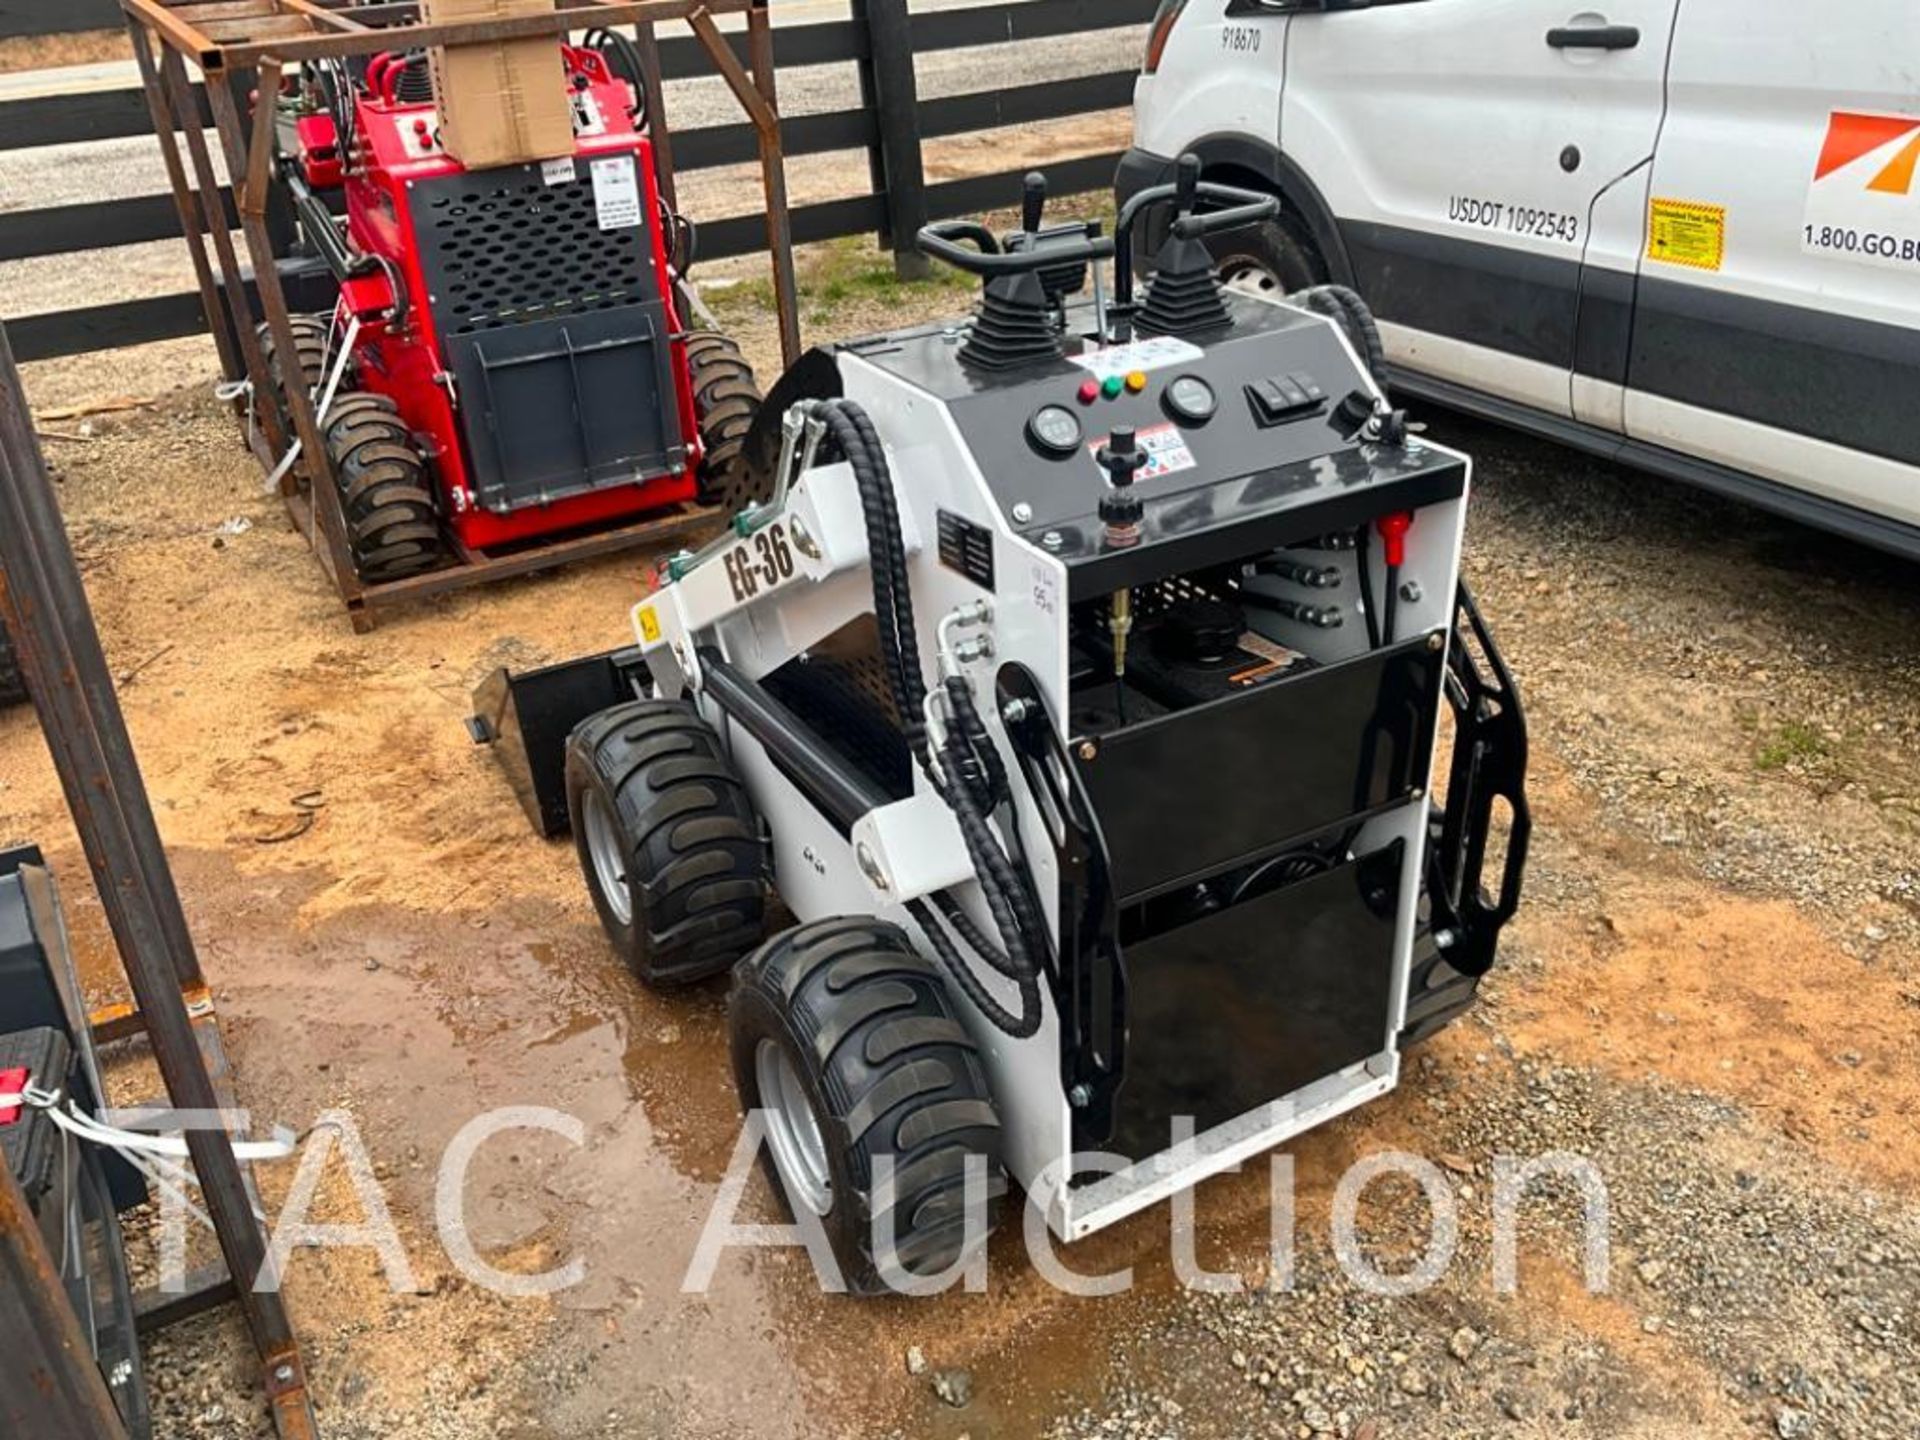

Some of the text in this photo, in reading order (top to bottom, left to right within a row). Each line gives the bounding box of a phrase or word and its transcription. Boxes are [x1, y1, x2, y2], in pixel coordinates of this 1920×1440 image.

[1222, 26, 1261, 52] 918670
[1449, 195, 1577, 242] USDOT 1092543
[722, 523, 794, 602] EG-36
